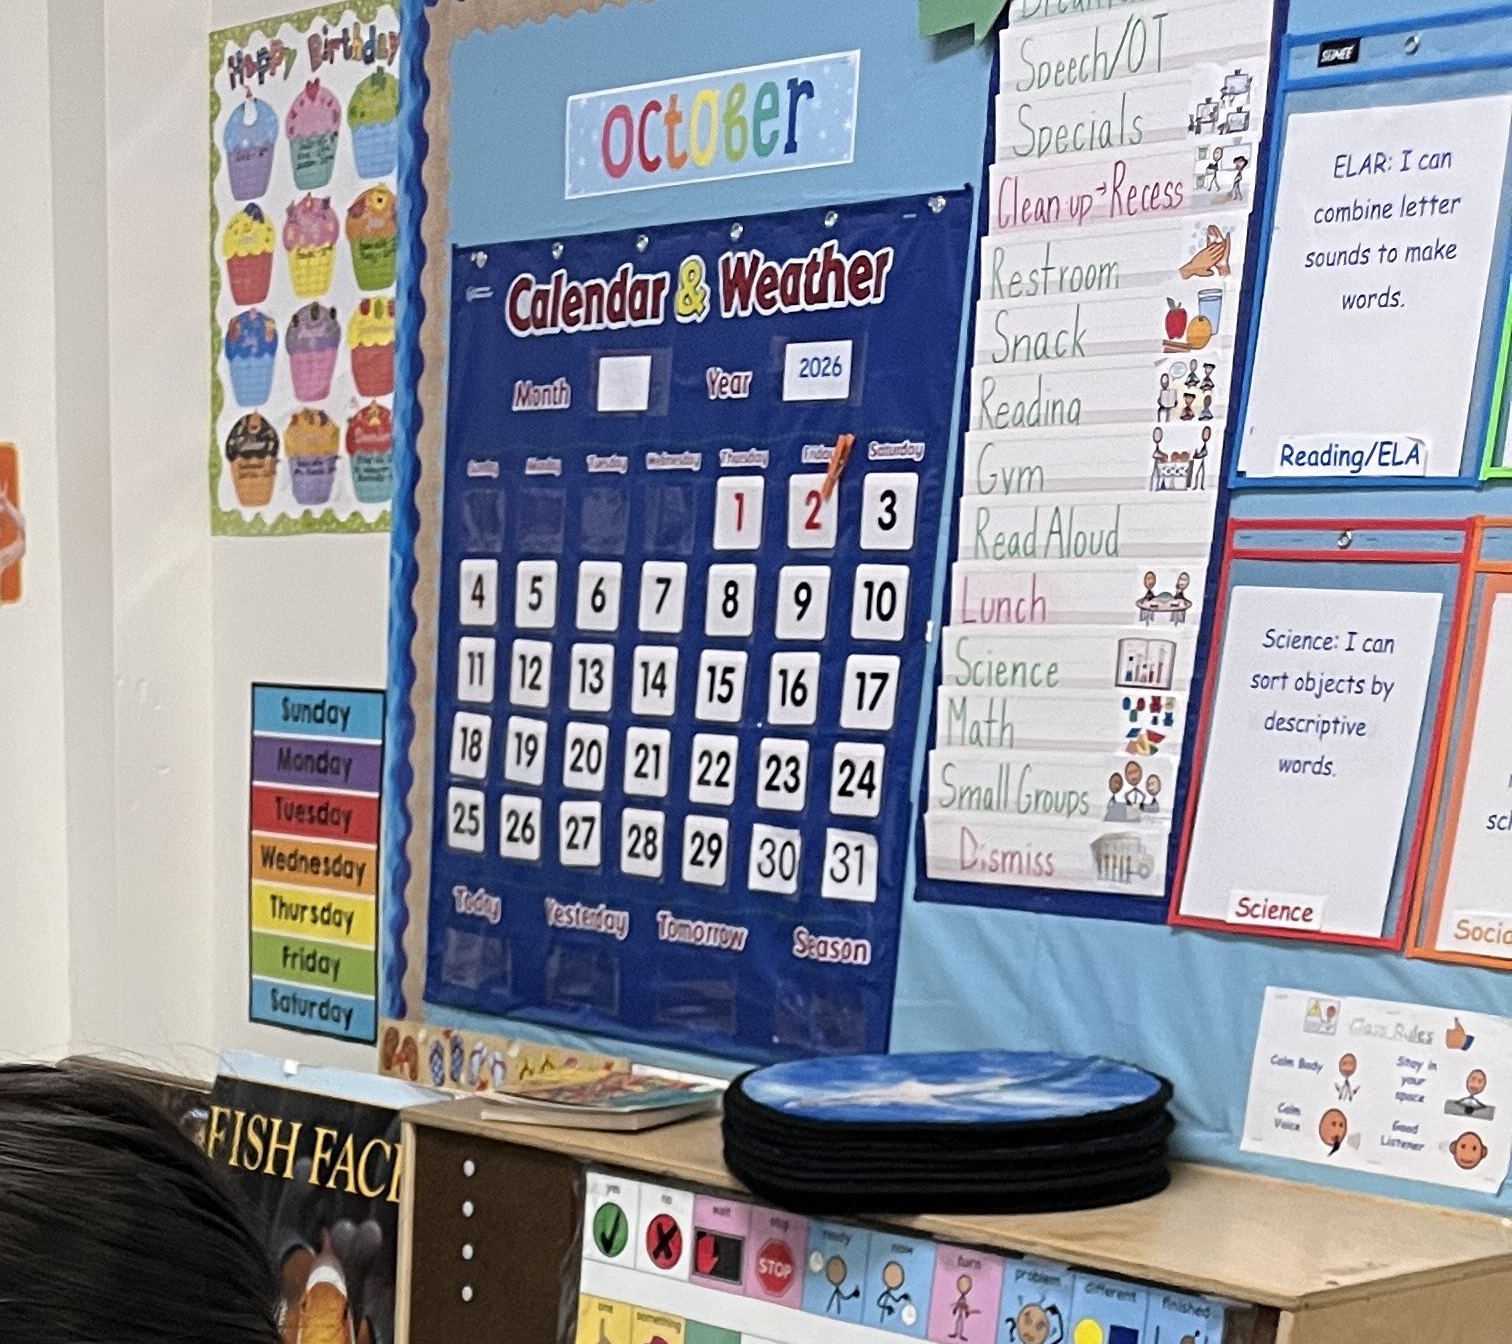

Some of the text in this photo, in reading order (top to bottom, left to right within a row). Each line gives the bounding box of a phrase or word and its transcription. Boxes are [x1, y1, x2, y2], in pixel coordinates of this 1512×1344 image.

[228, 22, 400, 89] Happy Birthday
[1017, 14, 1168, 92] Speech/OT
[1013, 95, 1143, 157] Specials
[1334, 150, 1452, 178] ELAR: I can
[1111, 160, 1183, 218] Recess
[1314, 194, 1461, 223] combine letter
[991, 242, 1119, 299] Restroom
[1305, 238, 1457, 268] sounds to make
[508, 244, 892, 335] Calendar & Weather
[1342, 286, 1405, 309] words.
[992, 304, 1086, 363] Snack
[513, 358, 842, 412] Month Year 2026
[803, 445, 835, 463] Frida
[869, 440, 924, 461] Saturday
[977, 443, 1043, 495] Gym
[1280, 440, 1419, 473] Reading/ELA
[735, 490, 896, 531] 1 2 3
[974, 504, 1120, 560] Read Aloud
[471, 575, 896, 621] 4 5 6 7 8 9 10
[962, 573, 1046, 623] Lunch
[956, 636, 1058, 687] Science
[1262, 628, 1394, 653] Science: I can
[467, 653, 888, 711] 11 12 13 14 15 16 17
[1250, 672, 1394, 702] sort objects by
[281, 697, 350, 732] Sunday
[947, 698, 1014, 747] Math
[1264, 710, 1366, 740] descriptive
[277, 748, 352, 782] Monday
[460, 727, 876, 798] 18 19 20 21 22 23 24
[1279, 755, 1336, 777] words.
[941, 763, 1089, 817] Small Groups
[274, 796, 352, 834] Tuesday
[260, 845, 366, 886] Wednesday
[453, 803, 865, 886] 25 26 27 28 29 30 31
[960, 826, 1054, 876] Dismiss
[270, 895, 354, 935] Thursday
[453, 887, 870, 965] Today Yesterday Tomorrow Season
[1236, 898, 1313, 922] Science
[282, 946, 340, 982] Friday
[271, 988, 353, 1031] Saturday
[1396, 1056, 1424, 1073] Stay
[207, 1106, 302, 1179] FISH
[759, 1258, 791, 1278] STOP
